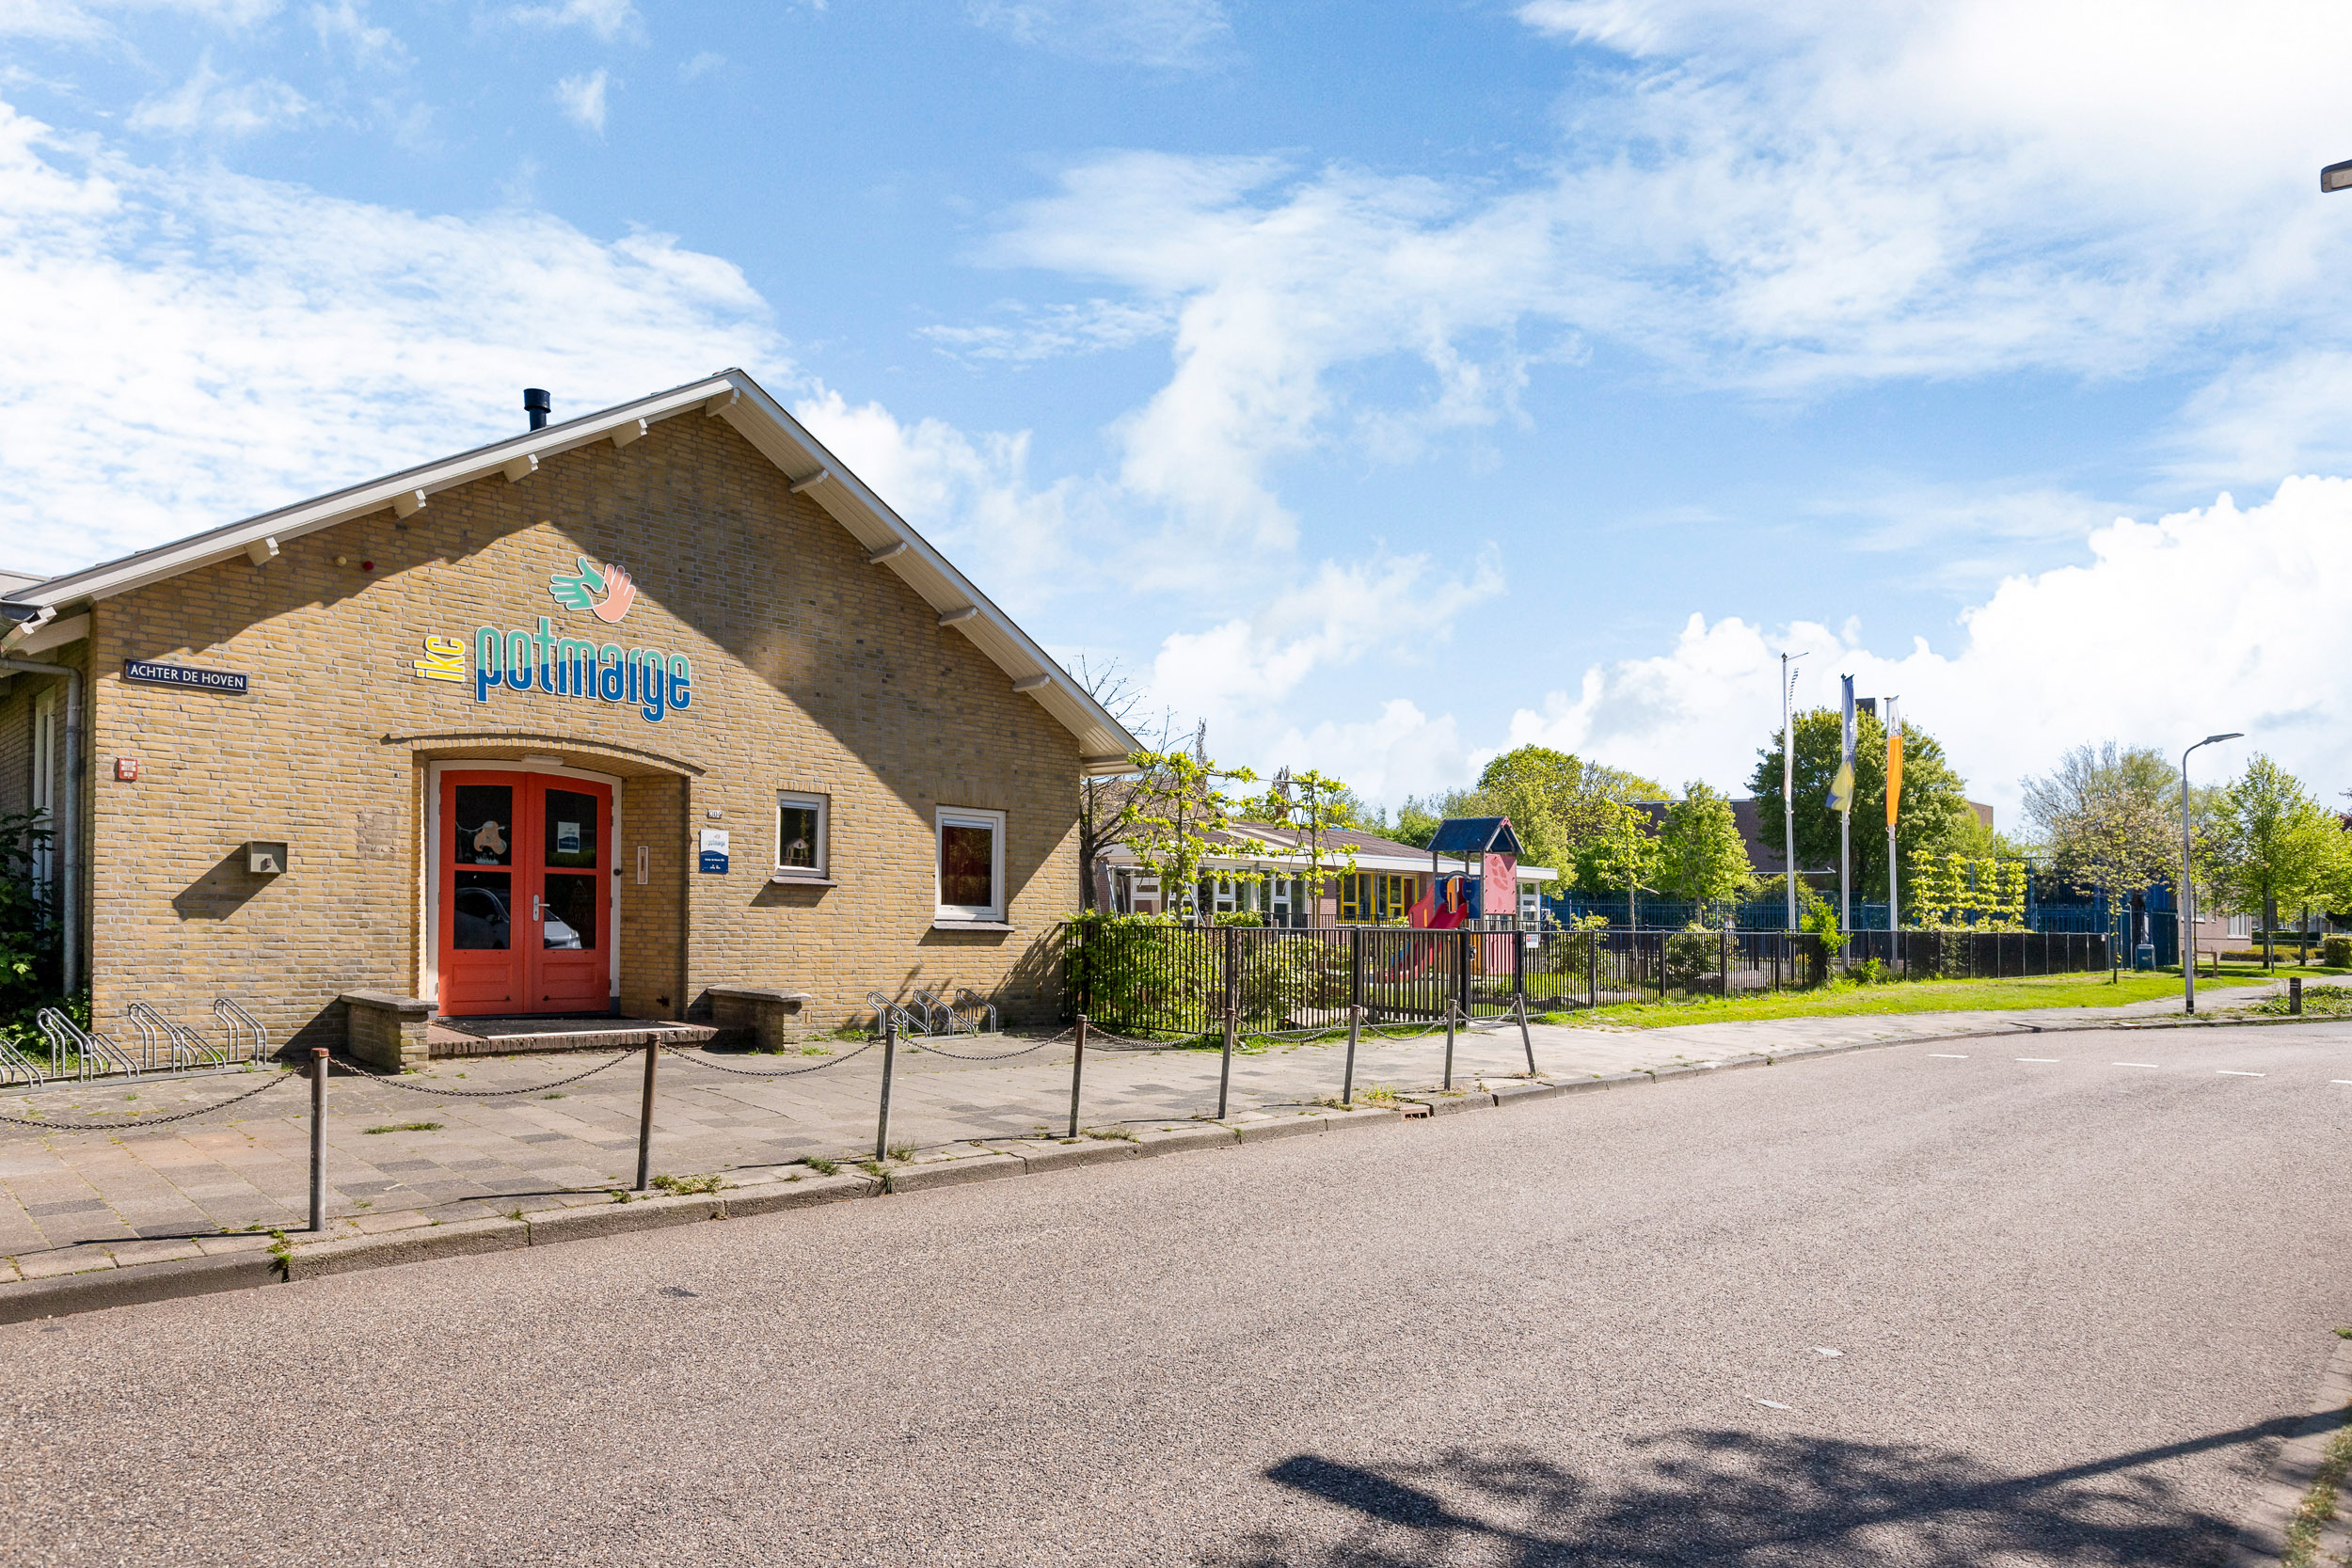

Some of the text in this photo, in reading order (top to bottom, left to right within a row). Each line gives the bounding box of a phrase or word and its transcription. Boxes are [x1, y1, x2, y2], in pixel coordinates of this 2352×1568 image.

[130, 664, 244, 689] ACHTER DE HOVEN
[414, 616, 691, 722] ikc potmarge
